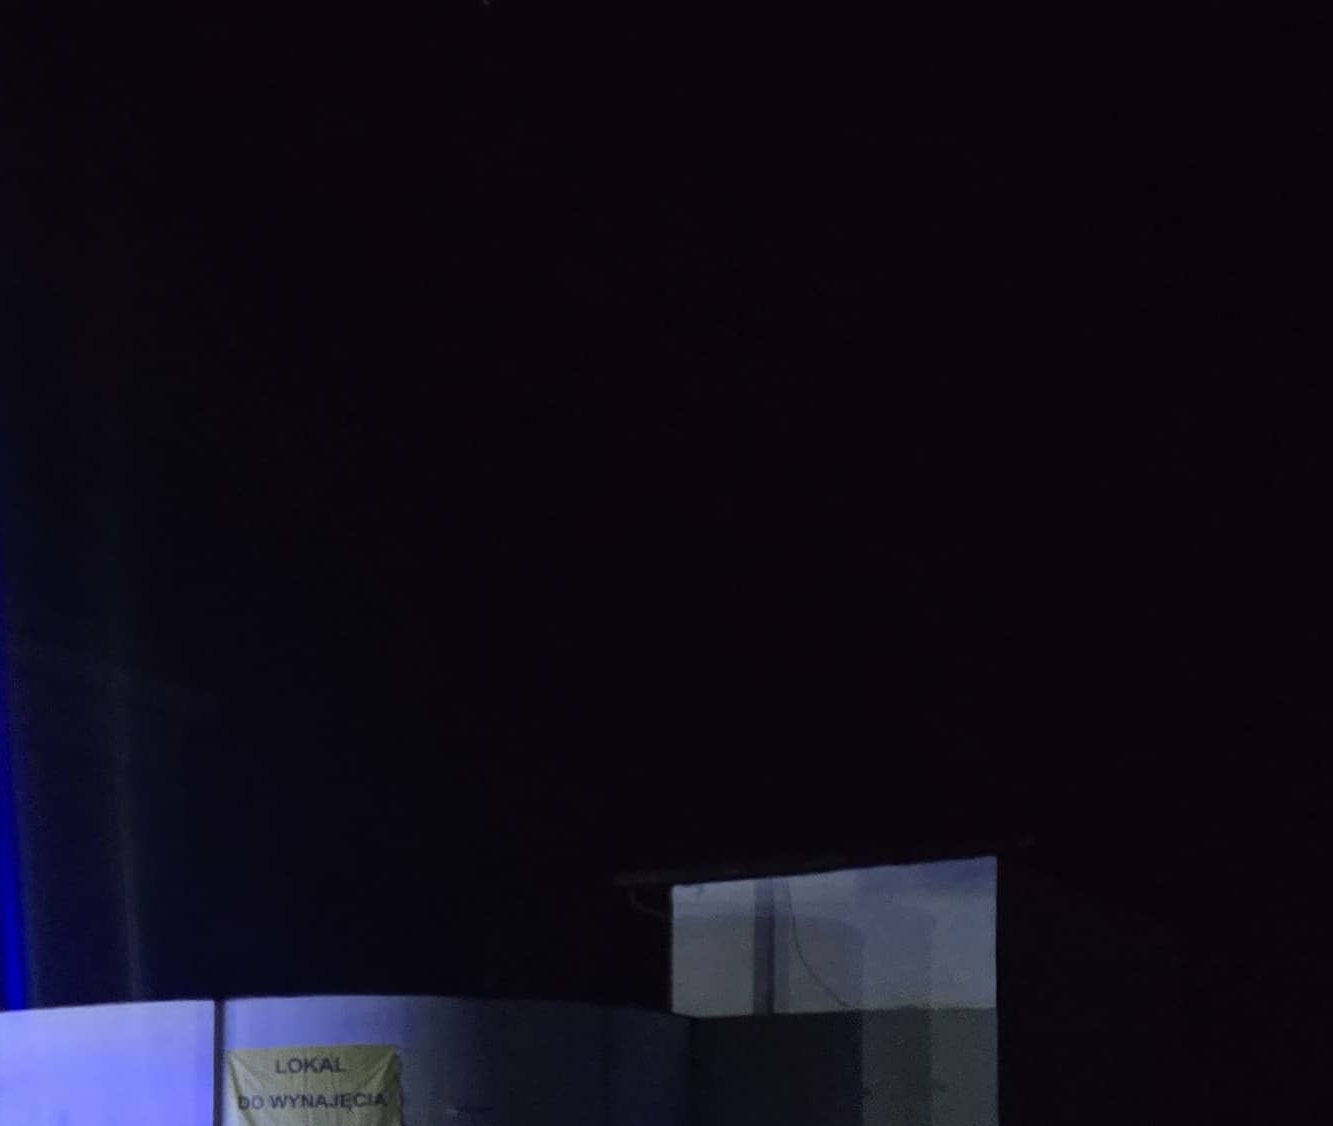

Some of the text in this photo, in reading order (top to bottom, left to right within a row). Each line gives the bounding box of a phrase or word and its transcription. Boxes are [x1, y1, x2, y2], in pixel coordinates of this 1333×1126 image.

[275, 1056, 346, 1075] LOKAL
[237, 1092, 387, 1112] DO WYNAJĘCIA
